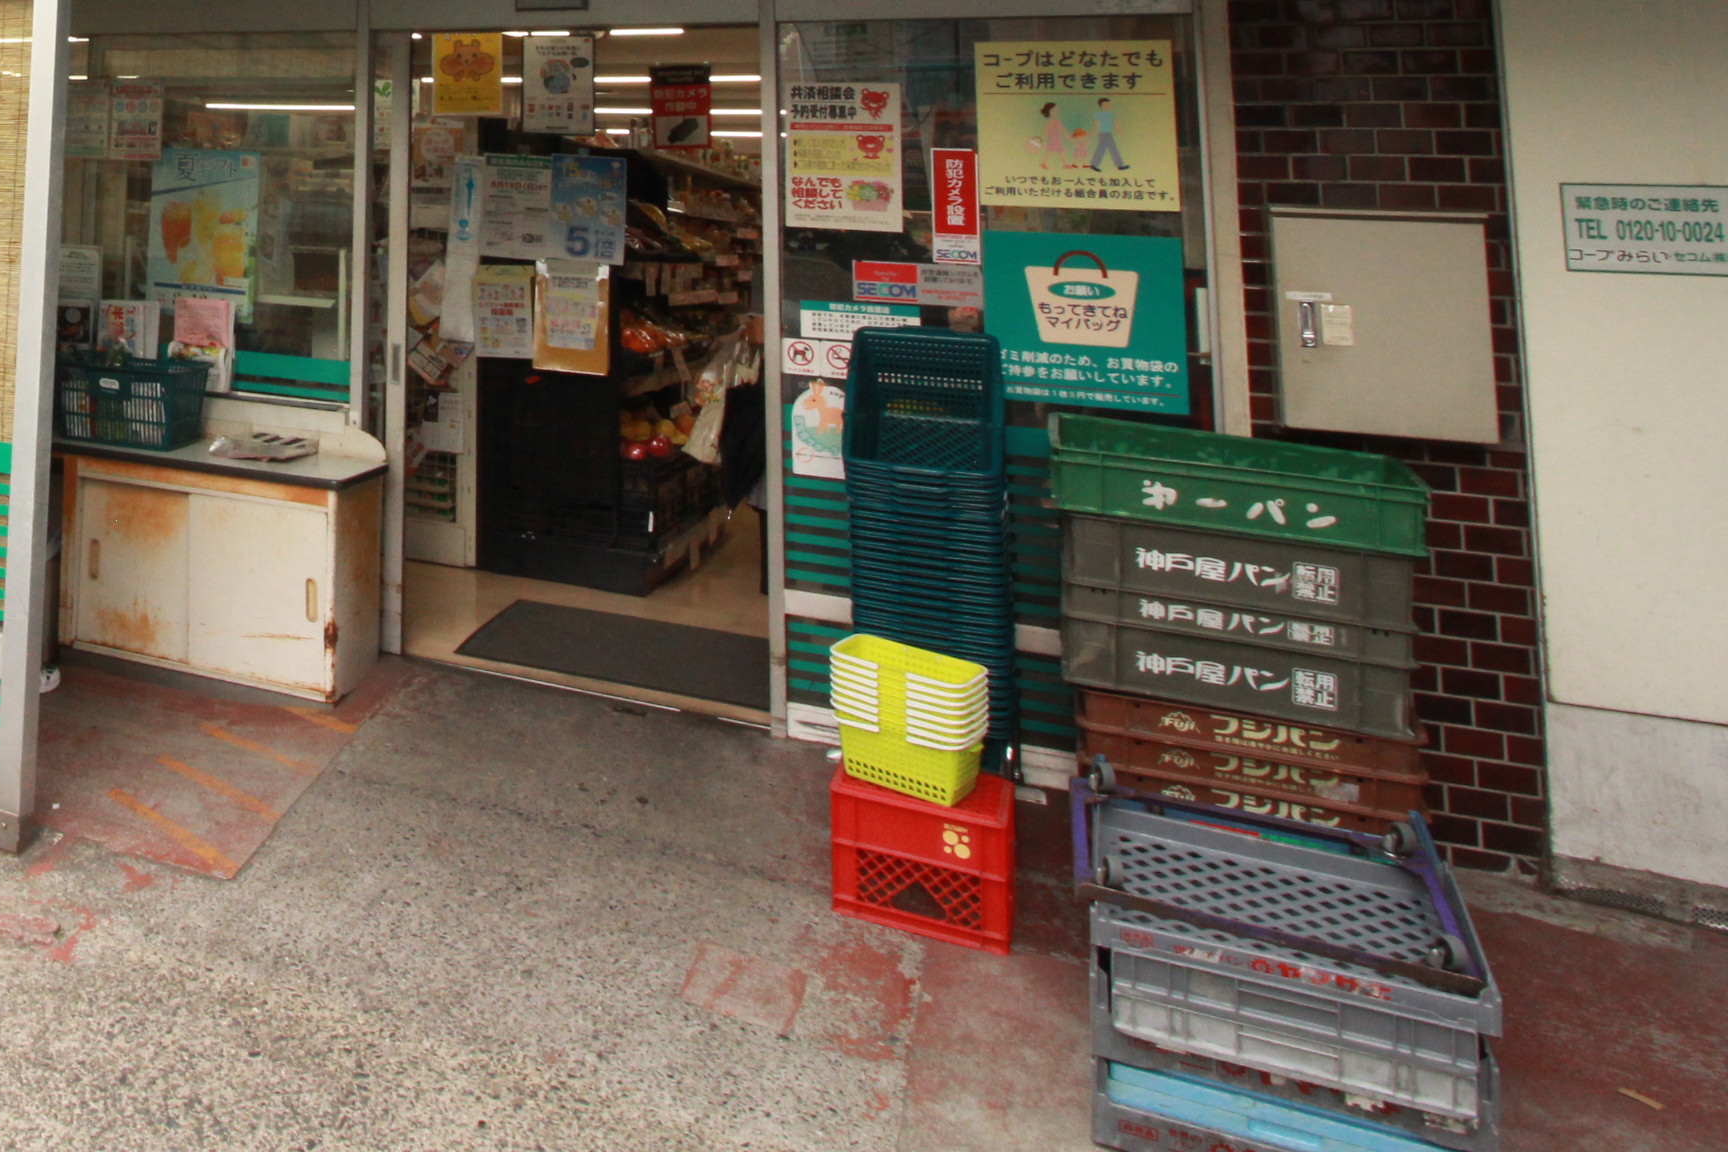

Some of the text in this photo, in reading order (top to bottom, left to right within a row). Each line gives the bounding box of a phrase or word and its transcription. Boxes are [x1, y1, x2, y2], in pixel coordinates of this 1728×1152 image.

[983, 49, 1163, 68] コープはどなたでも
[995, 72, 1142, 90] ご利用できます
[790, 86, 855, 100] 共済相談会
[791, 176, 843, 187] なんでも
[791, 187, 843, 199] 相談して
[945, 158, 966, 226] 防犯カメラ設置
[792, 199, 843, 210] ください
[1575, 196, 1720, 213] 緊急時のご連絡先
[1574, 218, 1725, 242] TEL 0120-10-0024
[936, 249, 977, 260] SECOM
[857, 282, 917, 298] SECOM
[1063, 284, 1101, 297] お願い
[1038, 302, 1128, 319] もってきてね
[1045, 316, 1121, 332] マイバッグ
[1135, 547, 1290, 587] 神戸屋パン
[1139, 599, 1285, 635] 神戸屋パン
[1136, 651, 1289, 691] 神戸屋パン
[1211, 714, 1342, 751] フジパン
[1211, 752, 1339, 787] フジパン
[1211, 788, 1340, 827] フジパン
